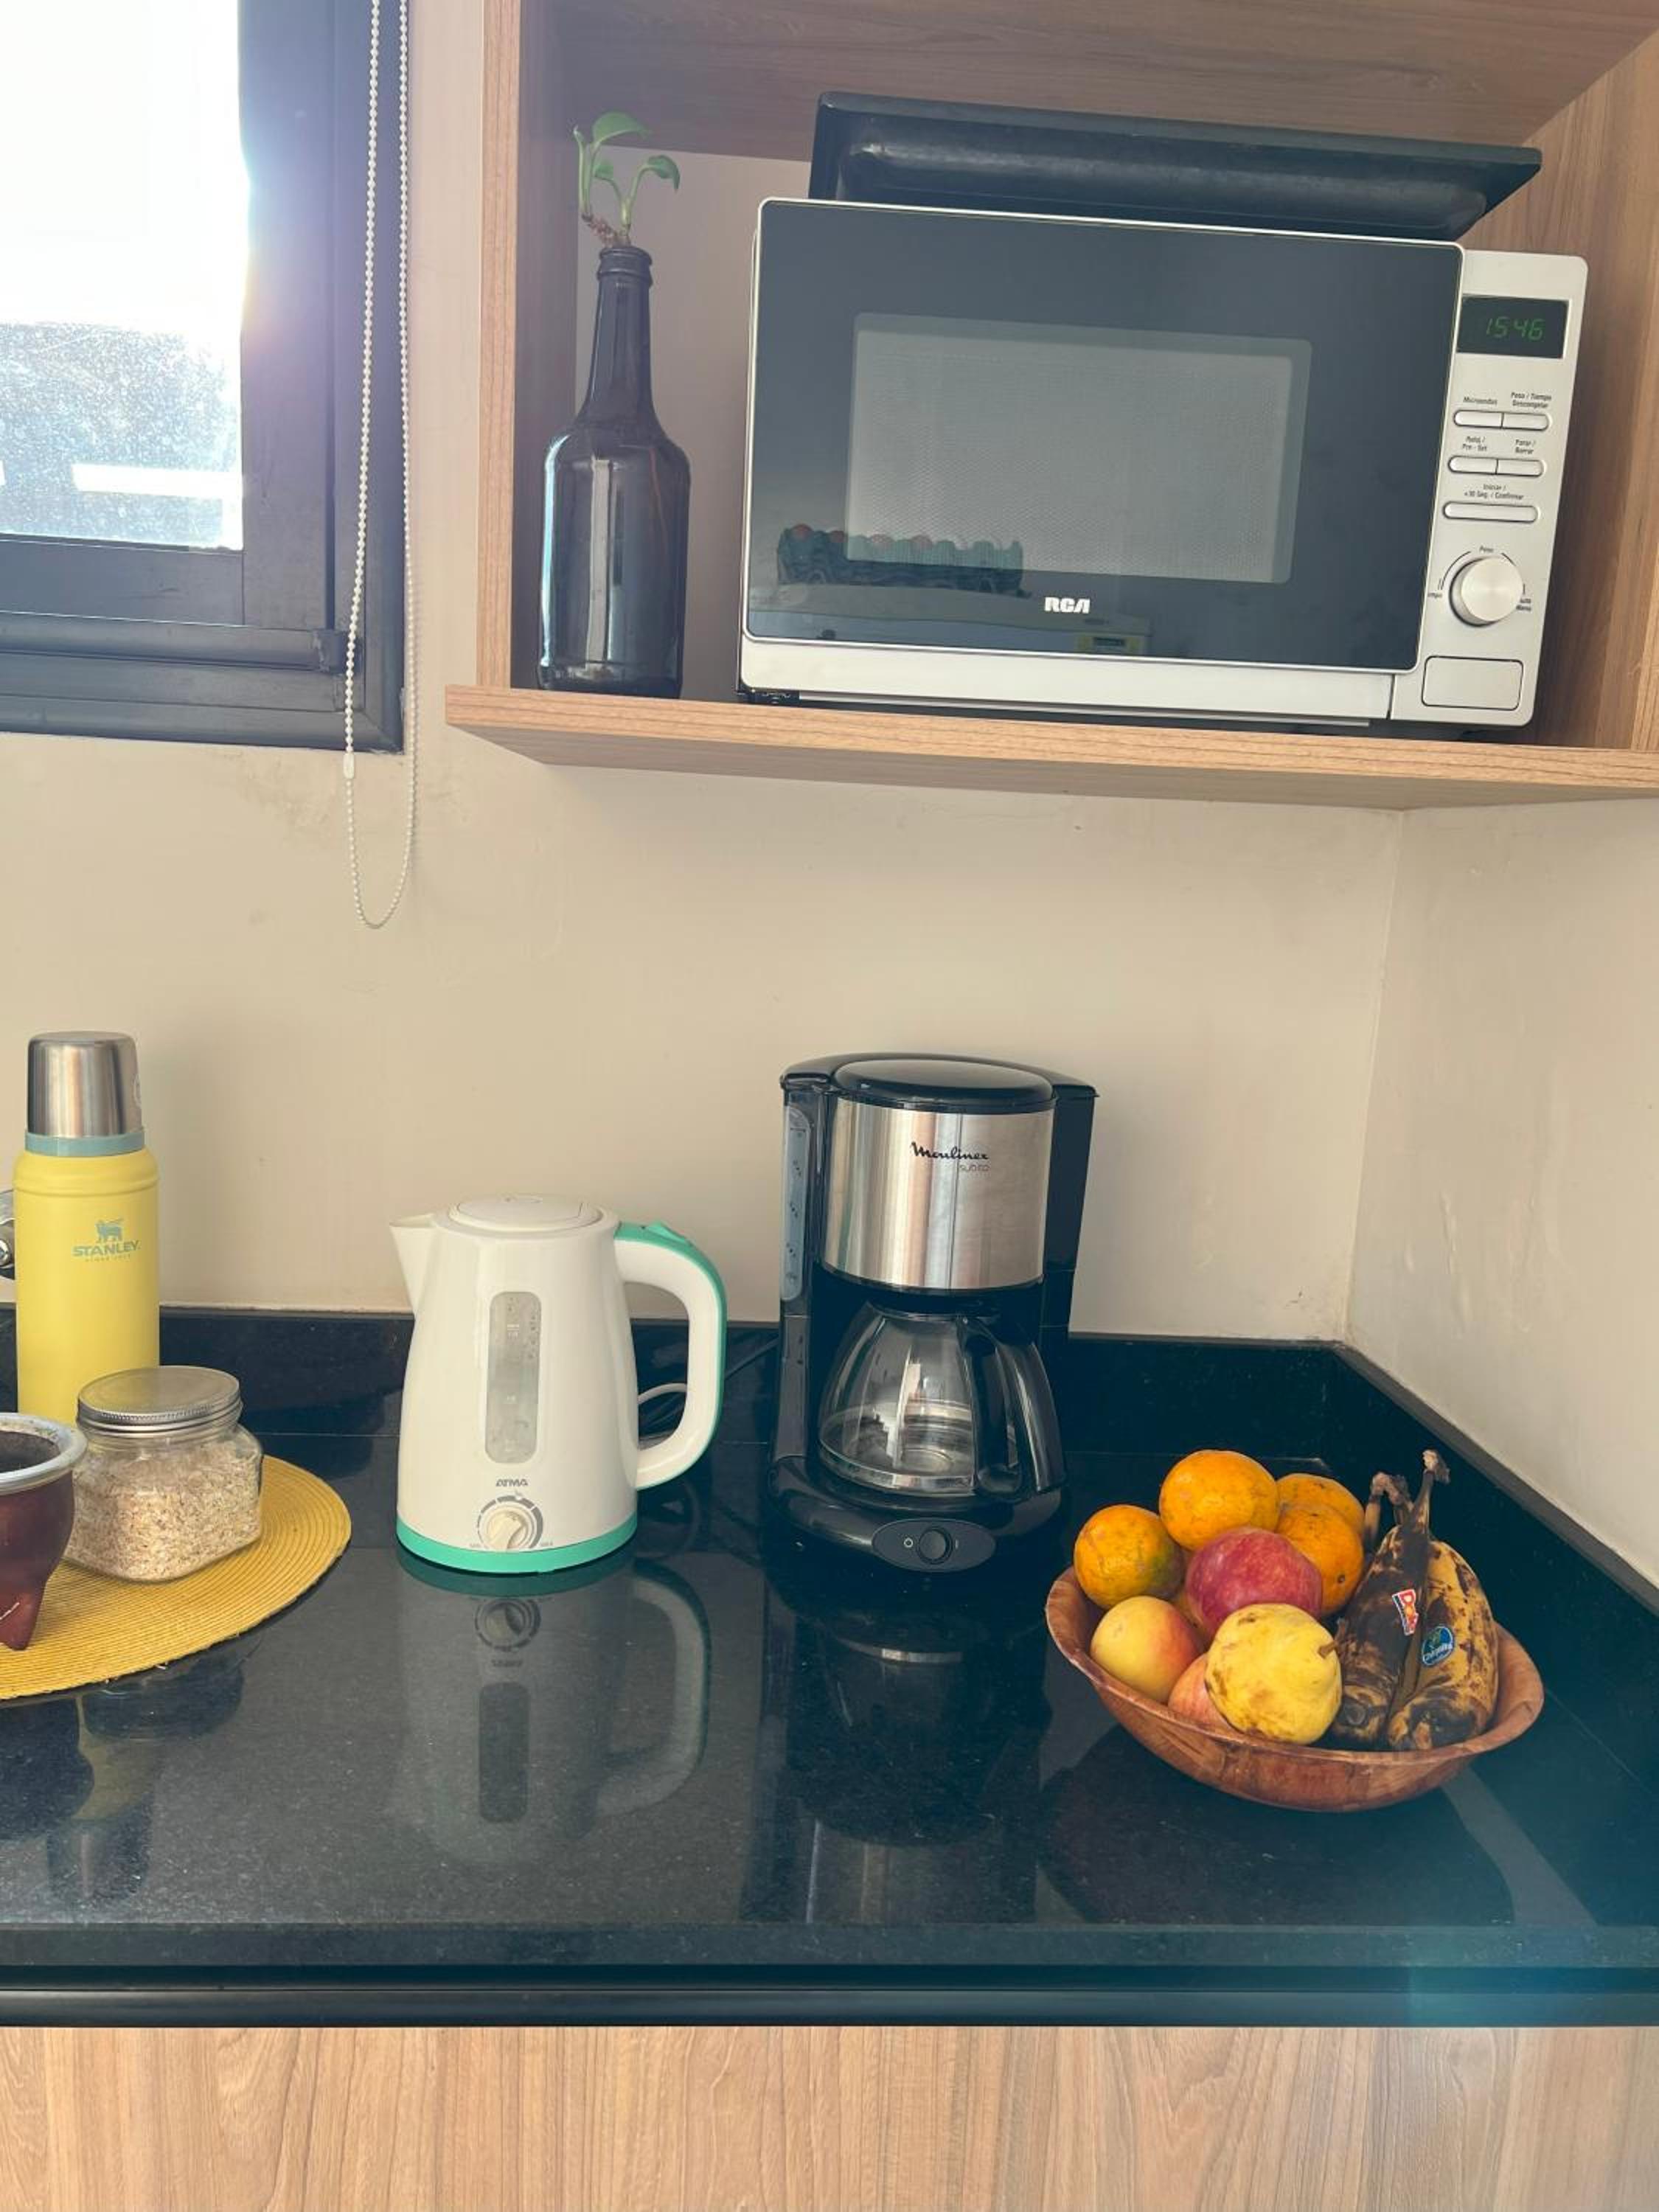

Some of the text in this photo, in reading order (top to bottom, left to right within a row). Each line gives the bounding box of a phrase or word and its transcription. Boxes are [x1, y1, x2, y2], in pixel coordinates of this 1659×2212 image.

[1044, 597, 1091, 613] RCA
[911, 1141, 990, 1160] Moulinex
[72, 1239, 139, 1257] STANLEY
